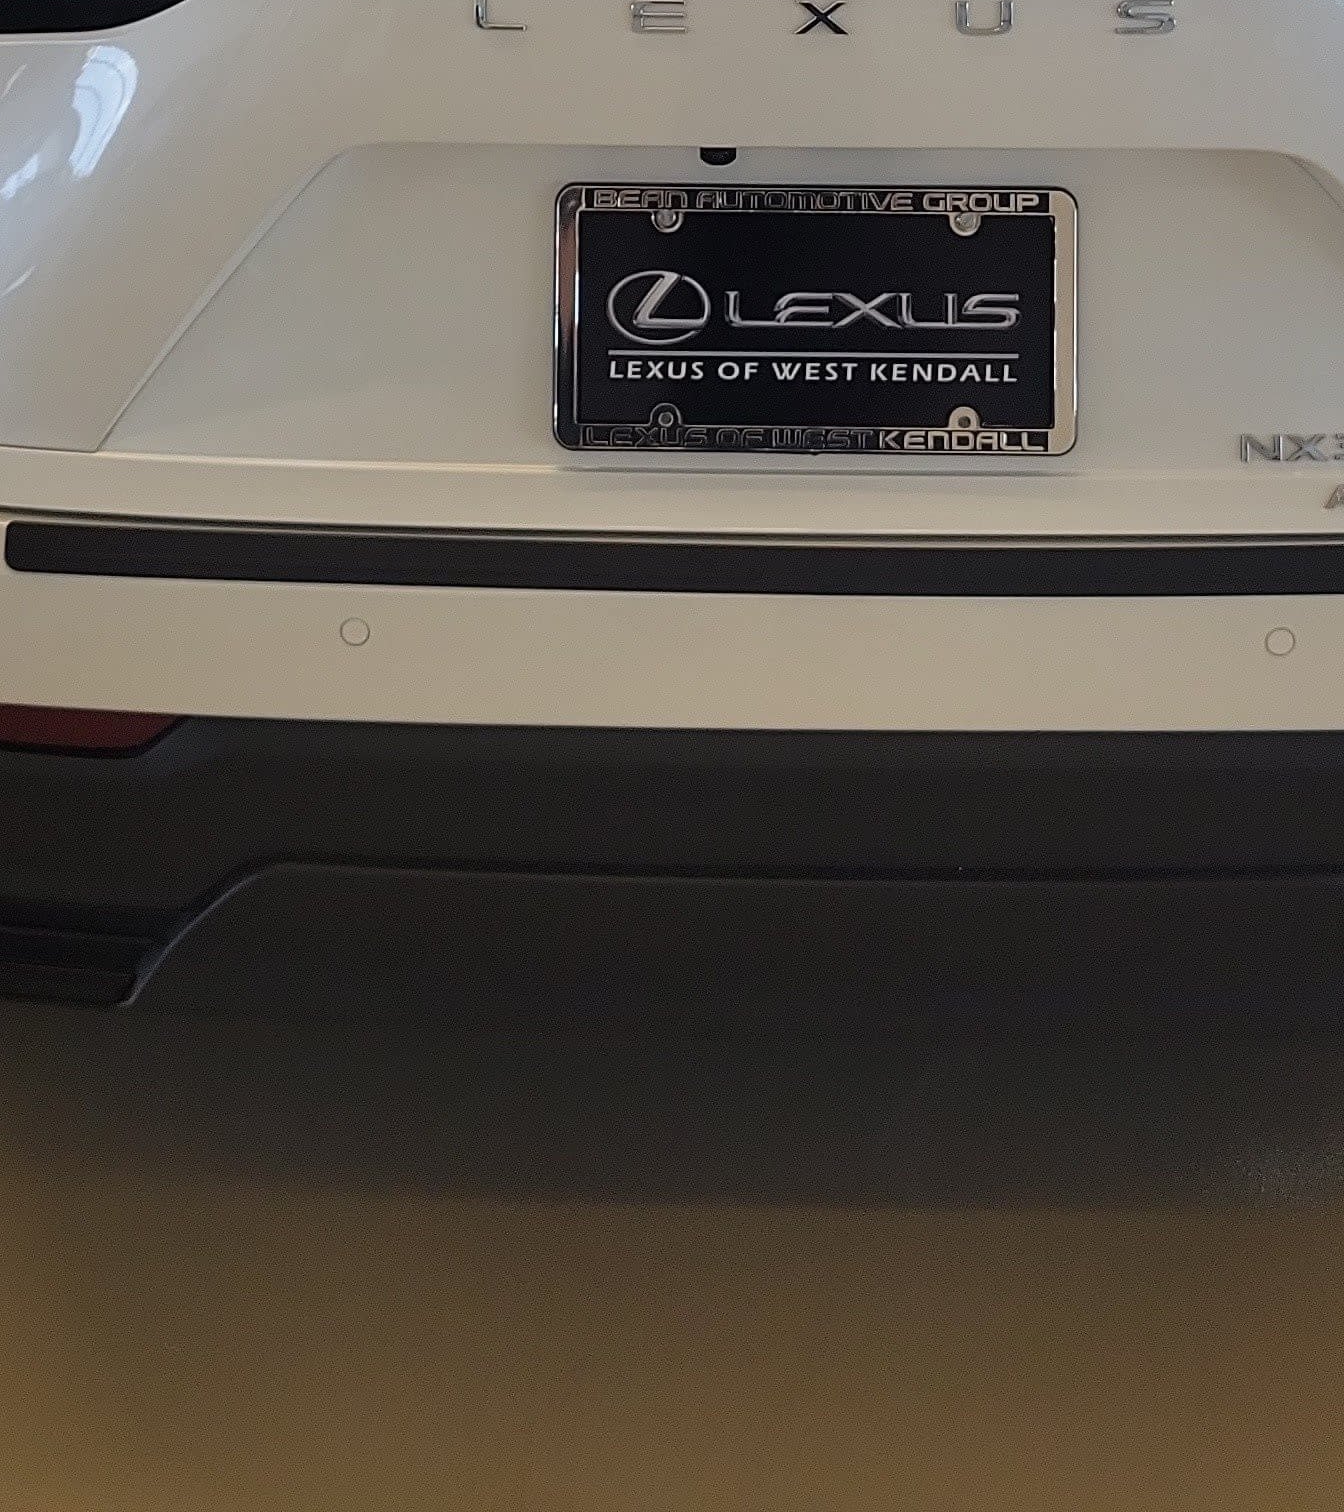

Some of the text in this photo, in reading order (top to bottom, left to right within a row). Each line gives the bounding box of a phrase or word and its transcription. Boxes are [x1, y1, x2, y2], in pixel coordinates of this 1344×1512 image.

[593, 189, 1040, 212] BEAN AUTOMOTIVE GROUP
[724, 291, 1021, 329] LEXUS
[609, 360, 1018, 383] LEXUS OF WEST KENDALL
[586, 427, 1045, 452] LEXUS OF WEST KENDALL
